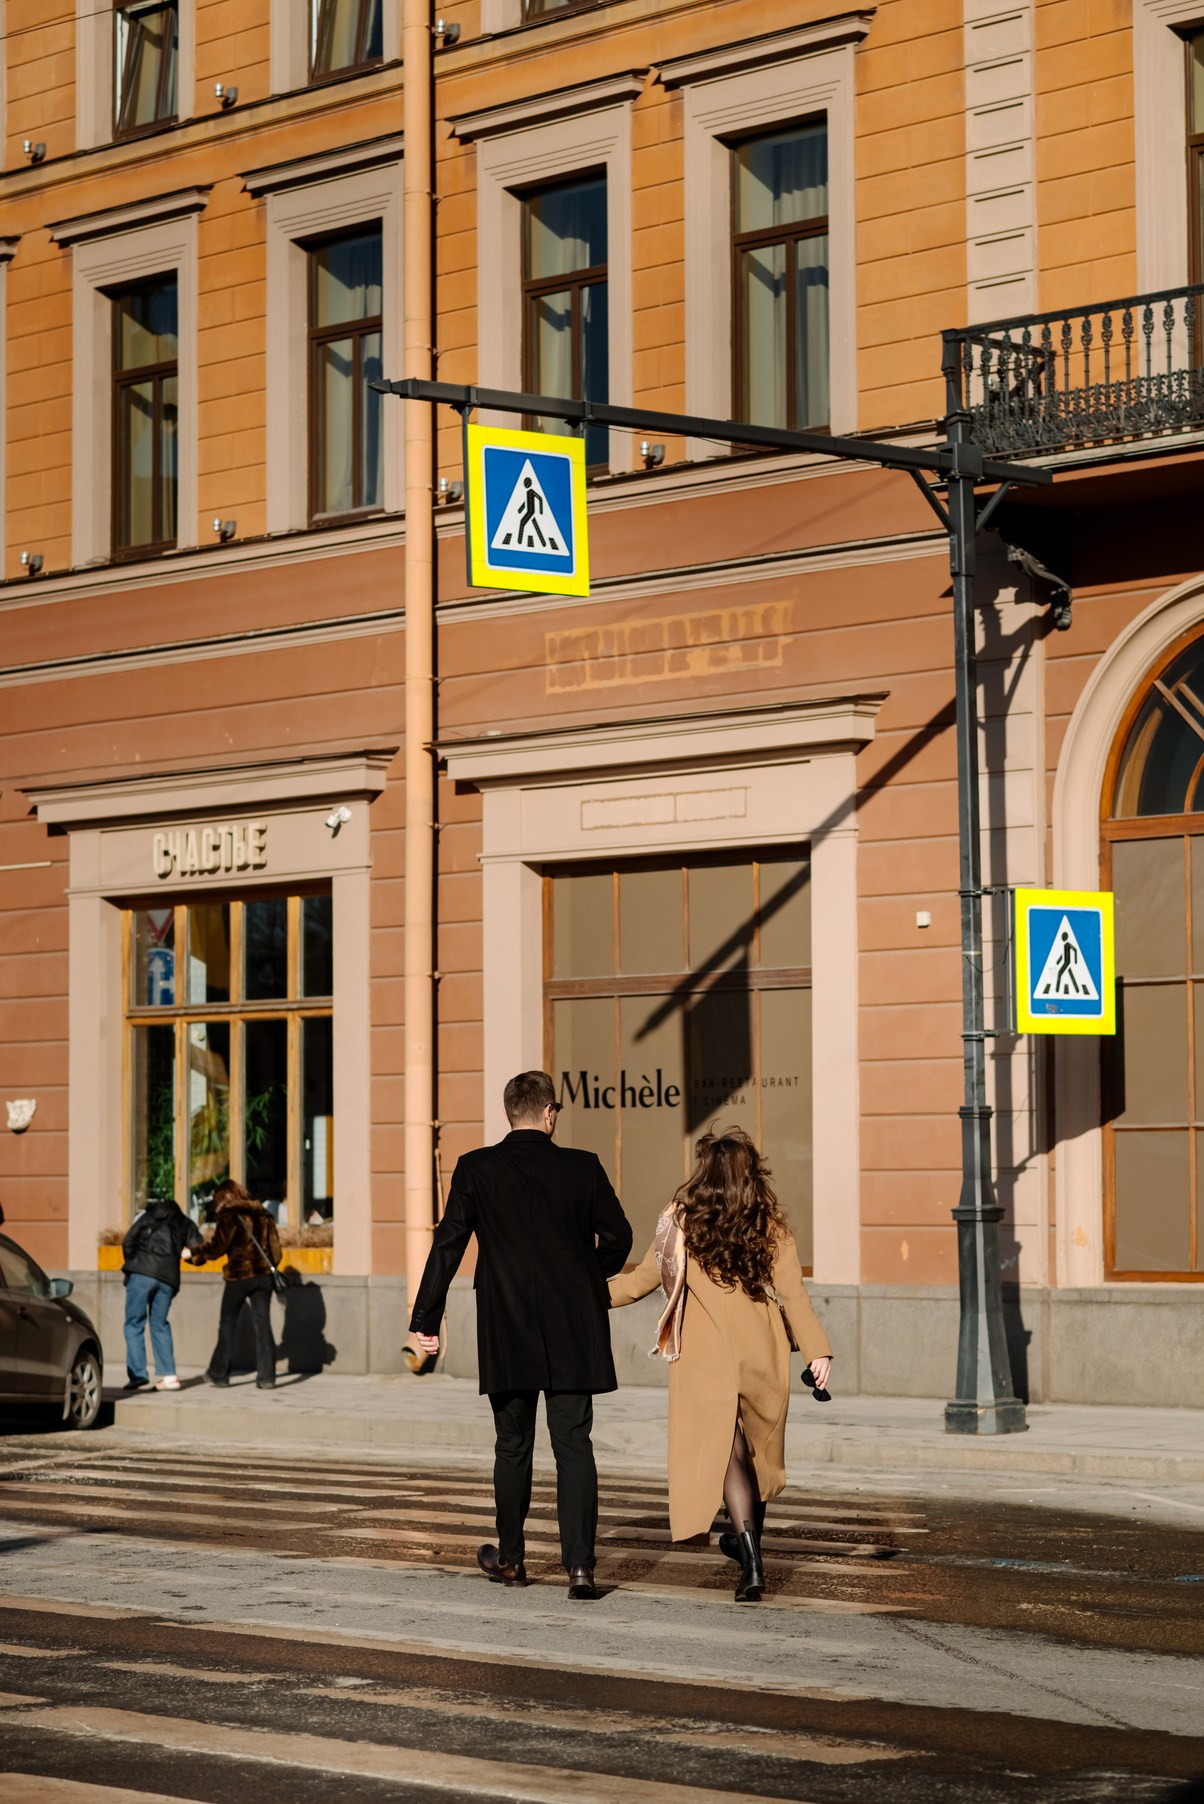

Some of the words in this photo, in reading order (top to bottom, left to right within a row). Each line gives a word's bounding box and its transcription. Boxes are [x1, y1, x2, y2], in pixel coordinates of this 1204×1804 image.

[153, 822, 267, 878] СЧАСТЬЕ
[560, 1068, 681, 1109] Michèle
[694, 1076, 799, 1089] BAR-RESTAURANT
[703, 1095, 747, 1106] CINEMA
